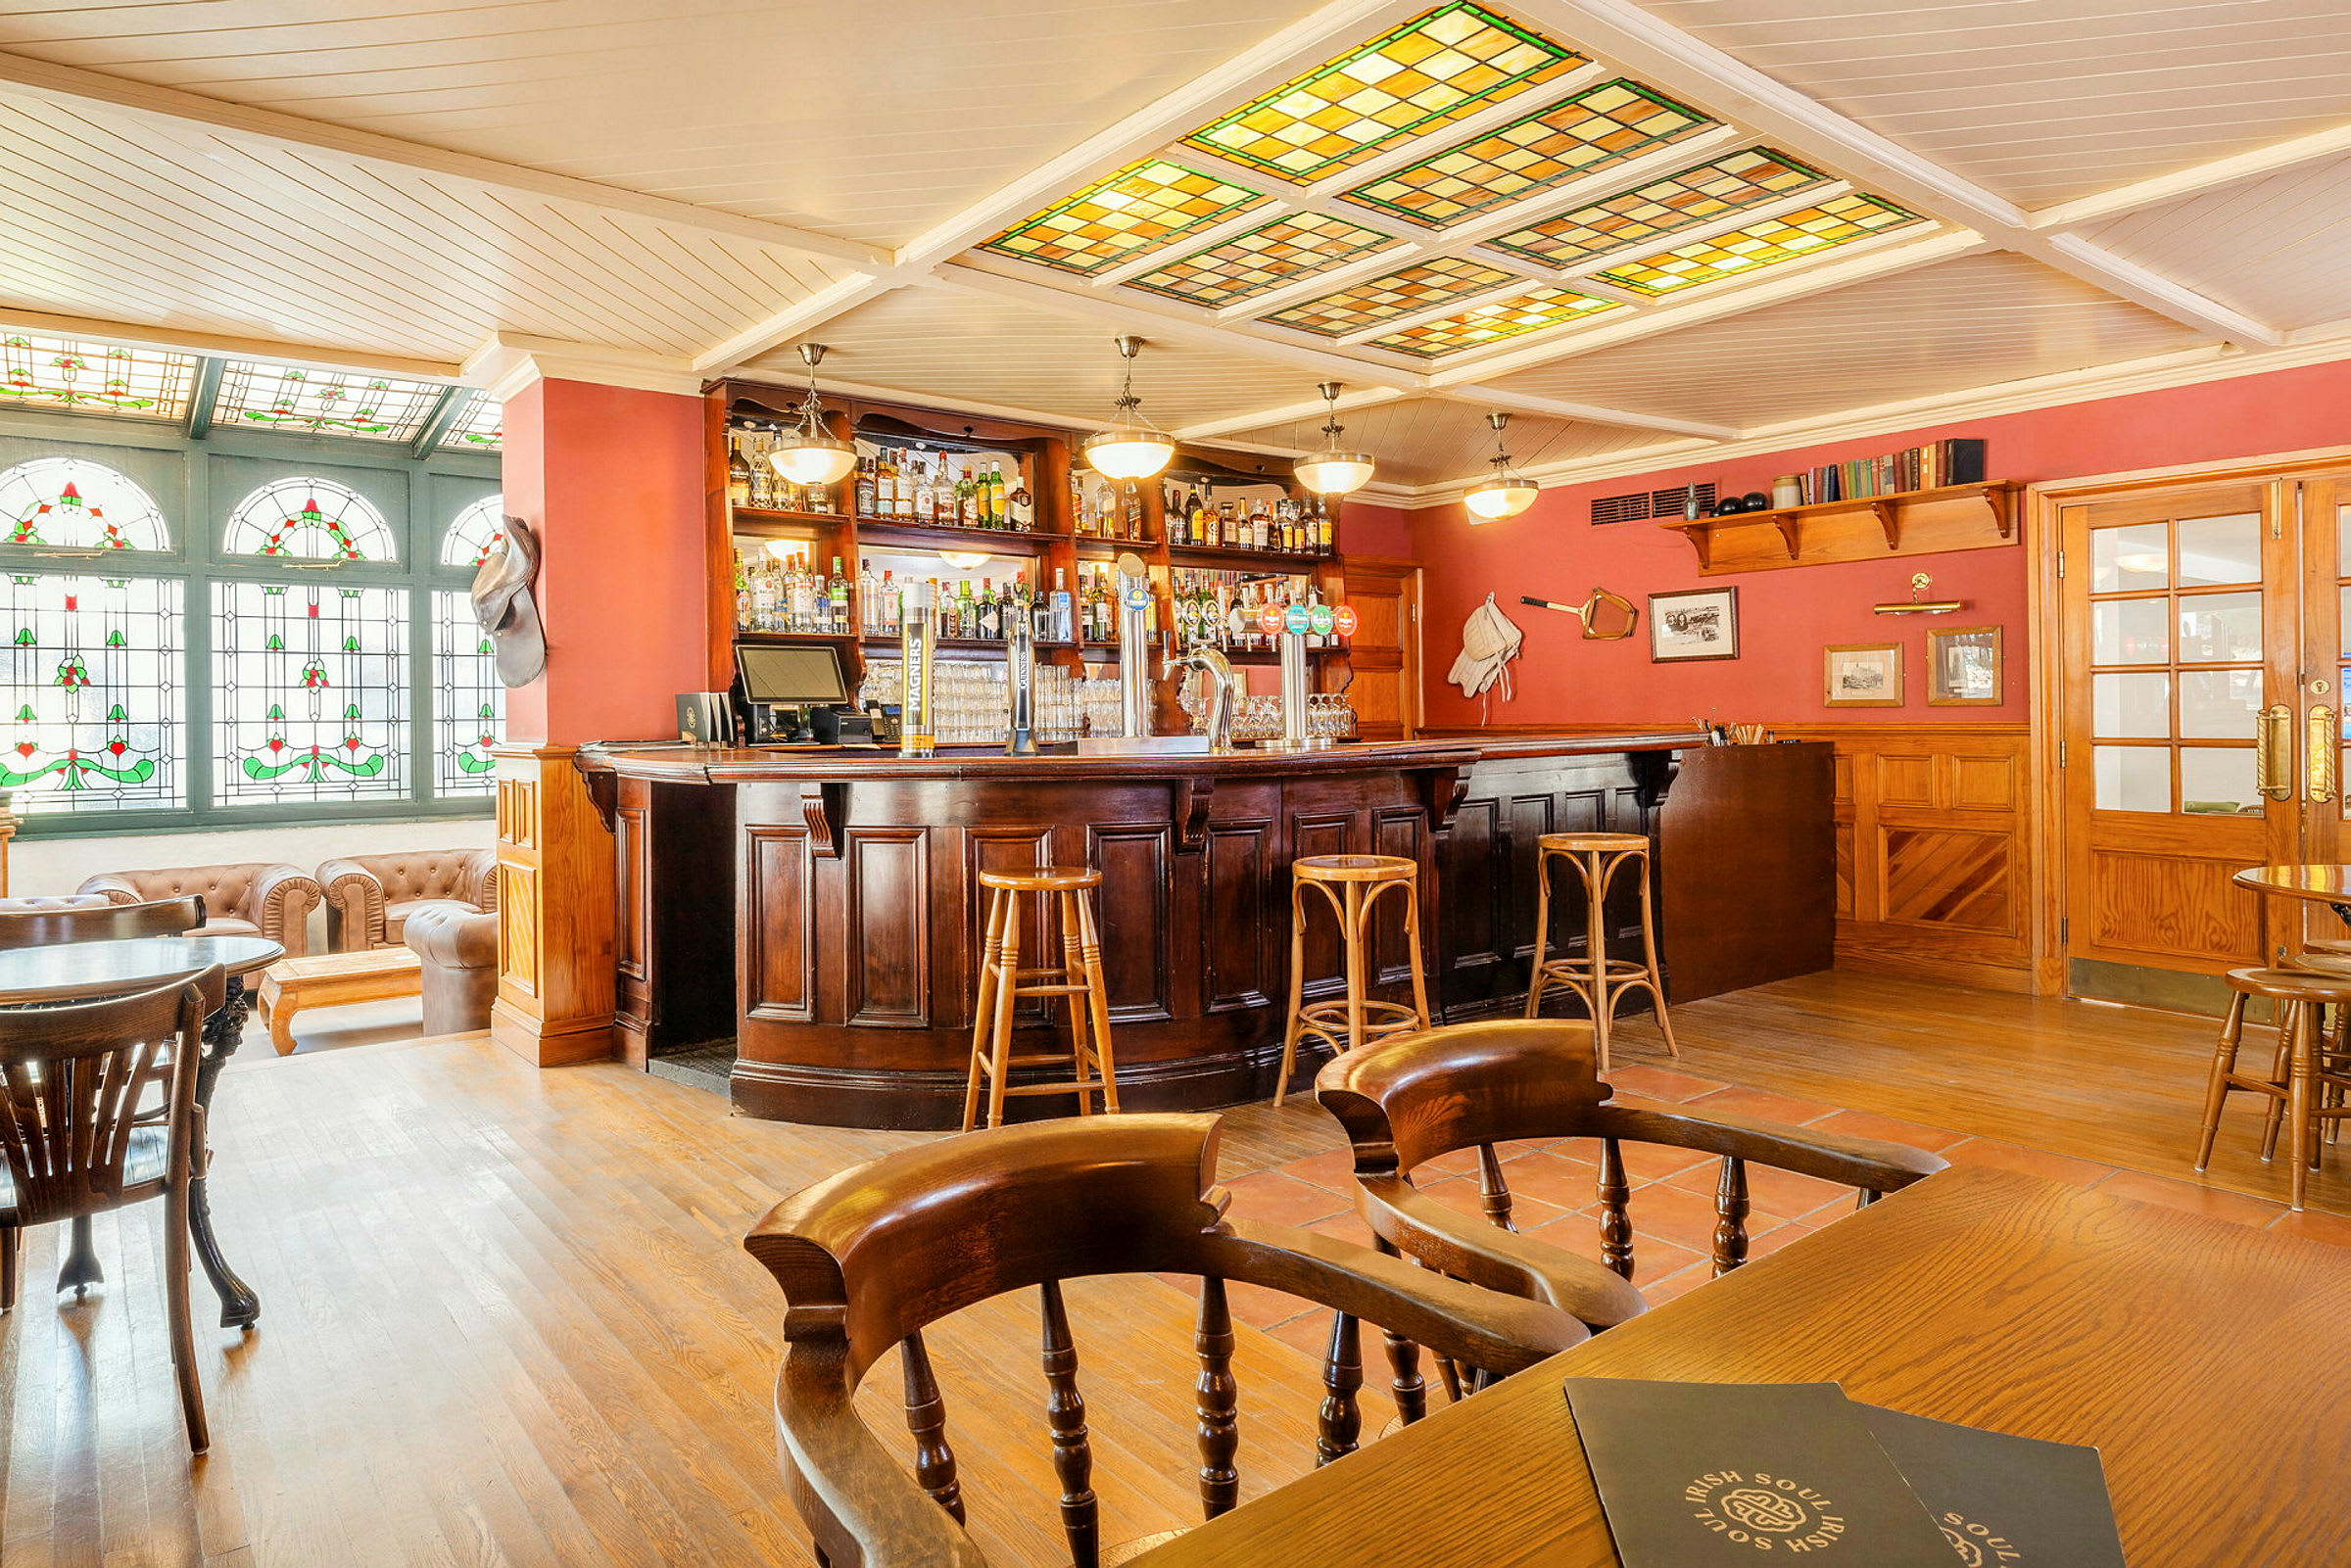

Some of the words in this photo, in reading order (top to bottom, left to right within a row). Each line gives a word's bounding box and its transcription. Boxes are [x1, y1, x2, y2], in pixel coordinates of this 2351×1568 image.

[908, 639, 922, 711] MAGNERS
[1685, 1470, 1744, 1503] IRISH
[1754, 1472, 1832, 1511] SOUL
[1693, 1507, 1772, 1550] SOUL
[1784, 1514, 1845, 1552] IRISH
[1943, 1511, 2021, 1561] SOUL
